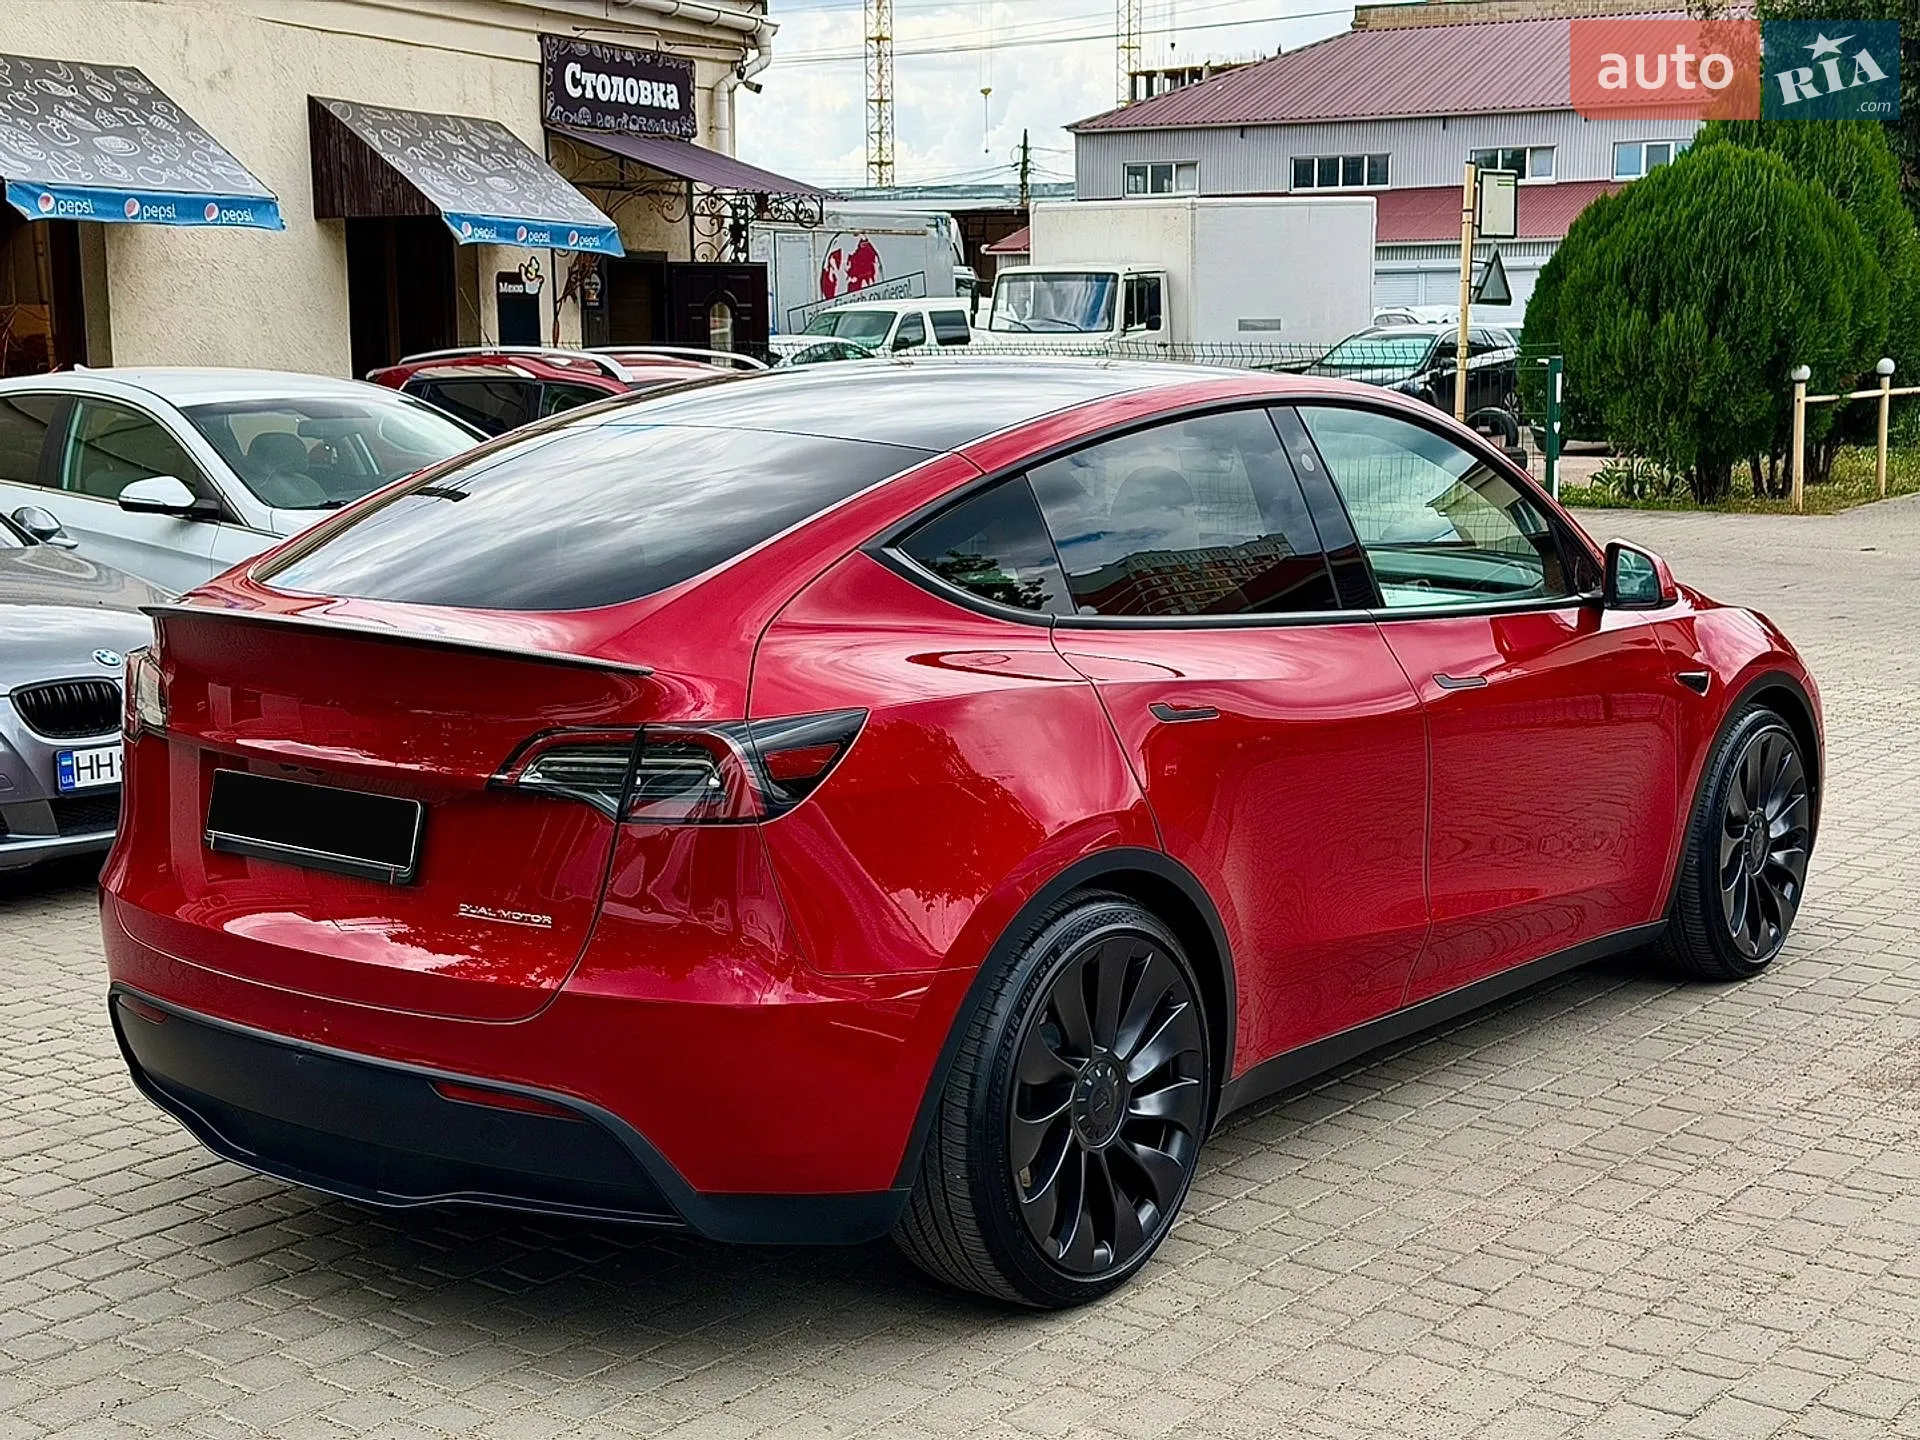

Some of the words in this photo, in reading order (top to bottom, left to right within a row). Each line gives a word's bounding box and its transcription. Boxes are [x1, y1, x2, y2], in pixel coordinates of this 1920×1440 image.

[564, 62, 680, 110] Столовка
[57, 199, 94, 215] pepsi
[142, 203, 176, 219] pepsi
[219, 208, 254, 223] pepsi
[473, 227, 497, 240] pepsi
[528, 231, 551, 243] pepsi
[579, 236, 600, 248] pepsi
[75, 752, 114, 781] HH
[61, 774, 74, 784] UA
[459, 903, 496, 917] DUAL
[497, 909, 552, 924] MOTOR
